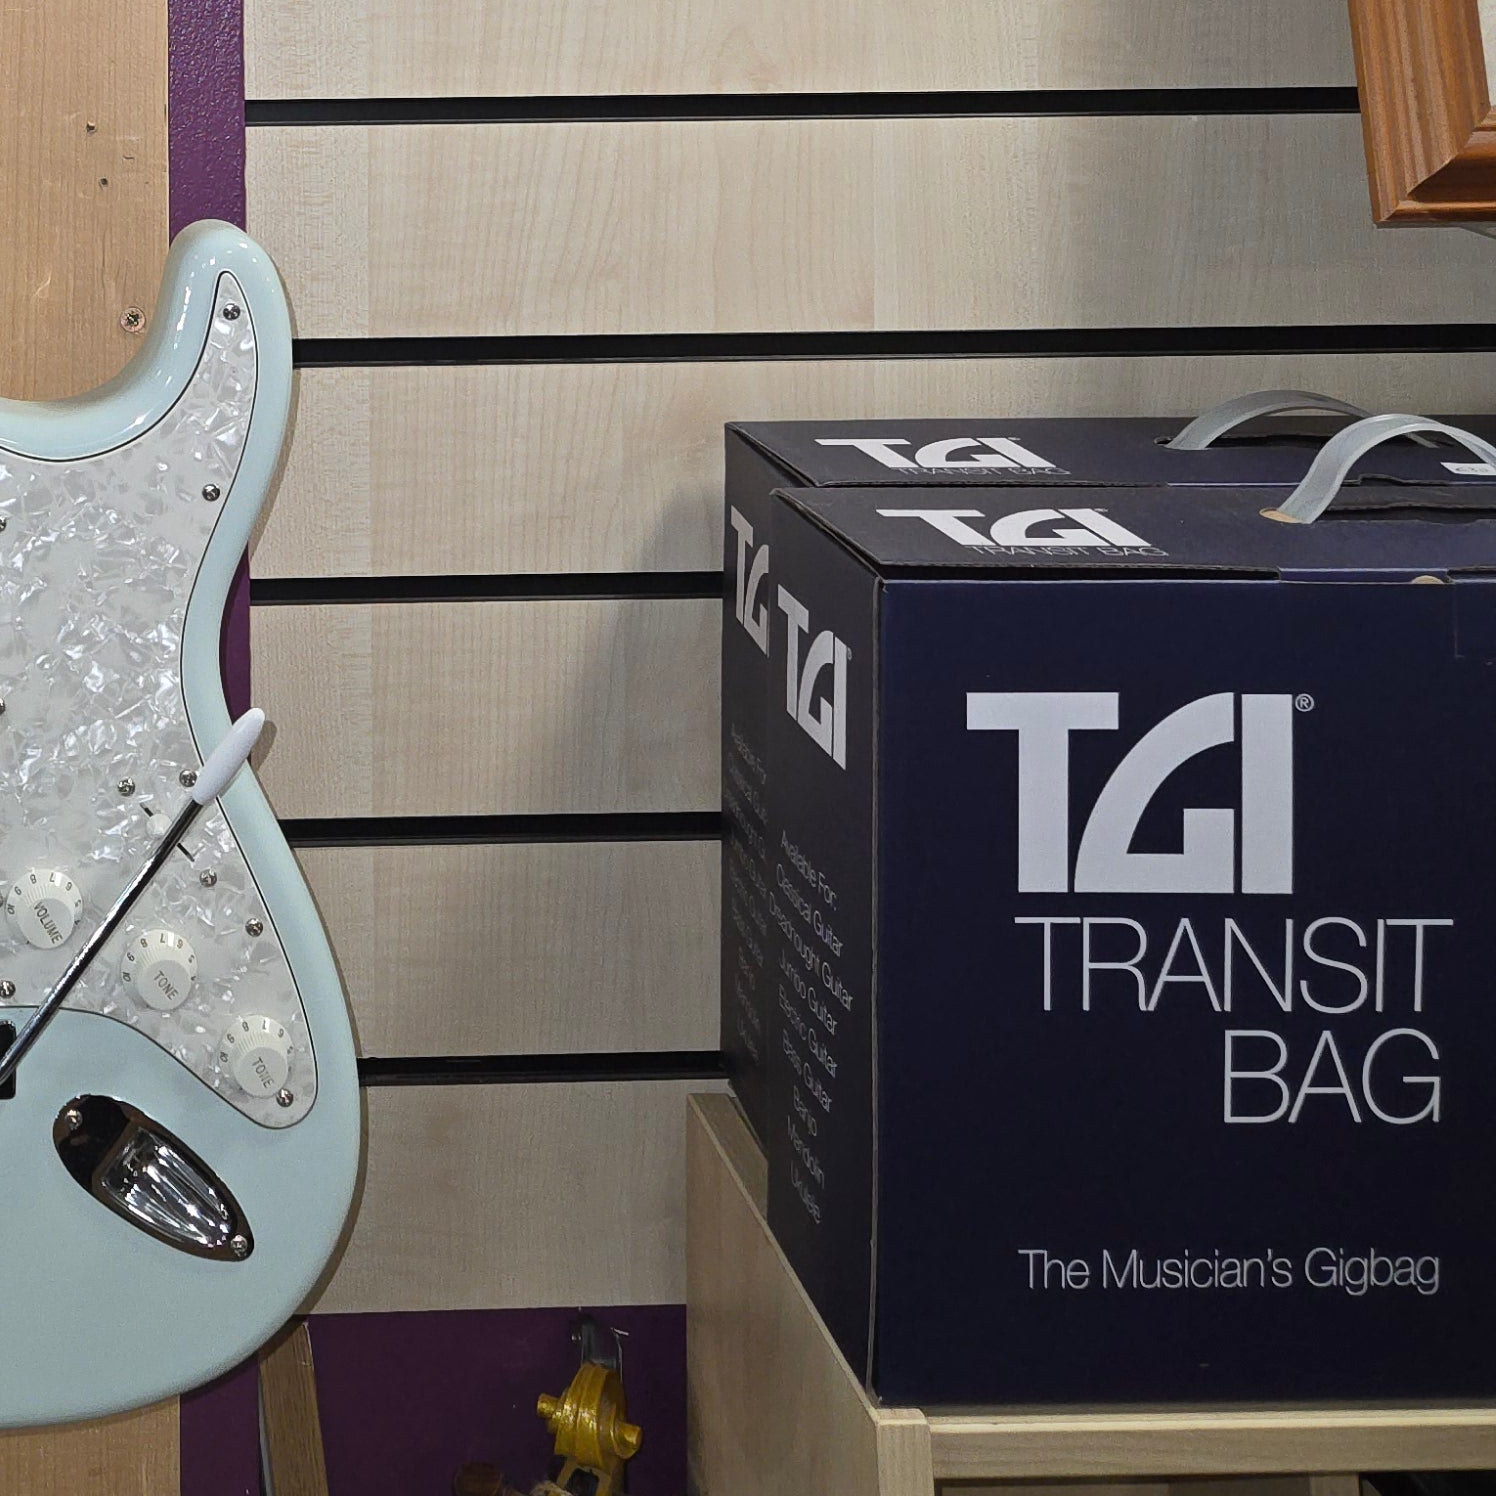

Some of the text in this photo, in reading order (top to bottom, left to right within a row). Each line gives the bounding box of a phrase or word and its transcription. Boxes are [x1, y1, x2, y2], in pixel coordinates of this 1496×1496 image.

[731, 505, 769, 658] TG
[34, 901, 63, 944] VOLUME
[813, 910, 843, 957] Guitar
[154, 970, 179, 1000] TONE
[821, 961, 854, 1011] Guitar
[1014, 916, 1454, 1013] TRANSIT
[807, 987, 838, 1036] Guitar
[252, 1057, 274, 1088] TONE
[808, 1027, 838, 1079] Guitar
[1224, 1028, 1442, 1125] BAG
[804, 1061, 833, 1113] Guitar
[1018, 1247, 1440, 1296] The Musician's Gigbag
